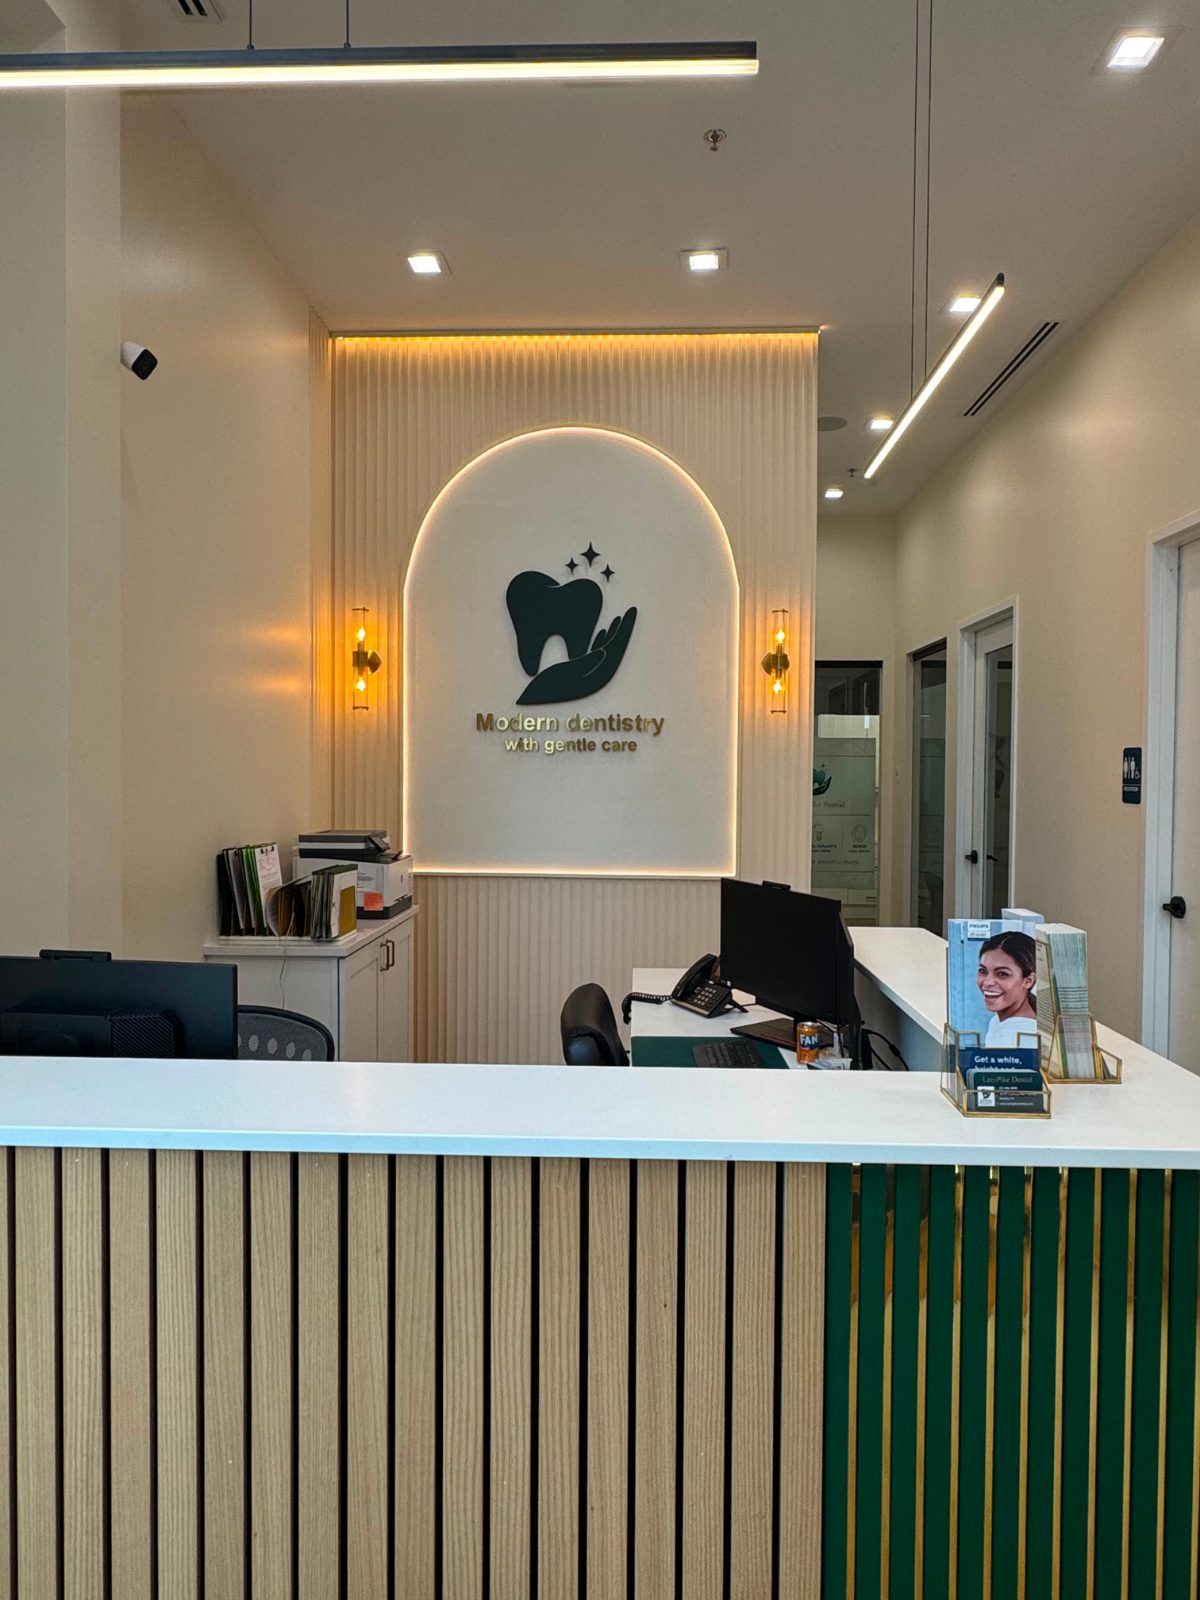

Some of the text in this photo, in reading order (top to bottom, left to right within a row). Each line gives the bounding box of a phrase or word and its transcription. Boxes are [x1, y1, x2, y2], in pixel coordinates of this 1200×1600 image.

[476, 712, 665, 736] Modern dentistry
[504, 737, 638, 755] with gentle care
[974, 1055, 989, 1064] Get
[997, 1056, 1022, 1065] white,
